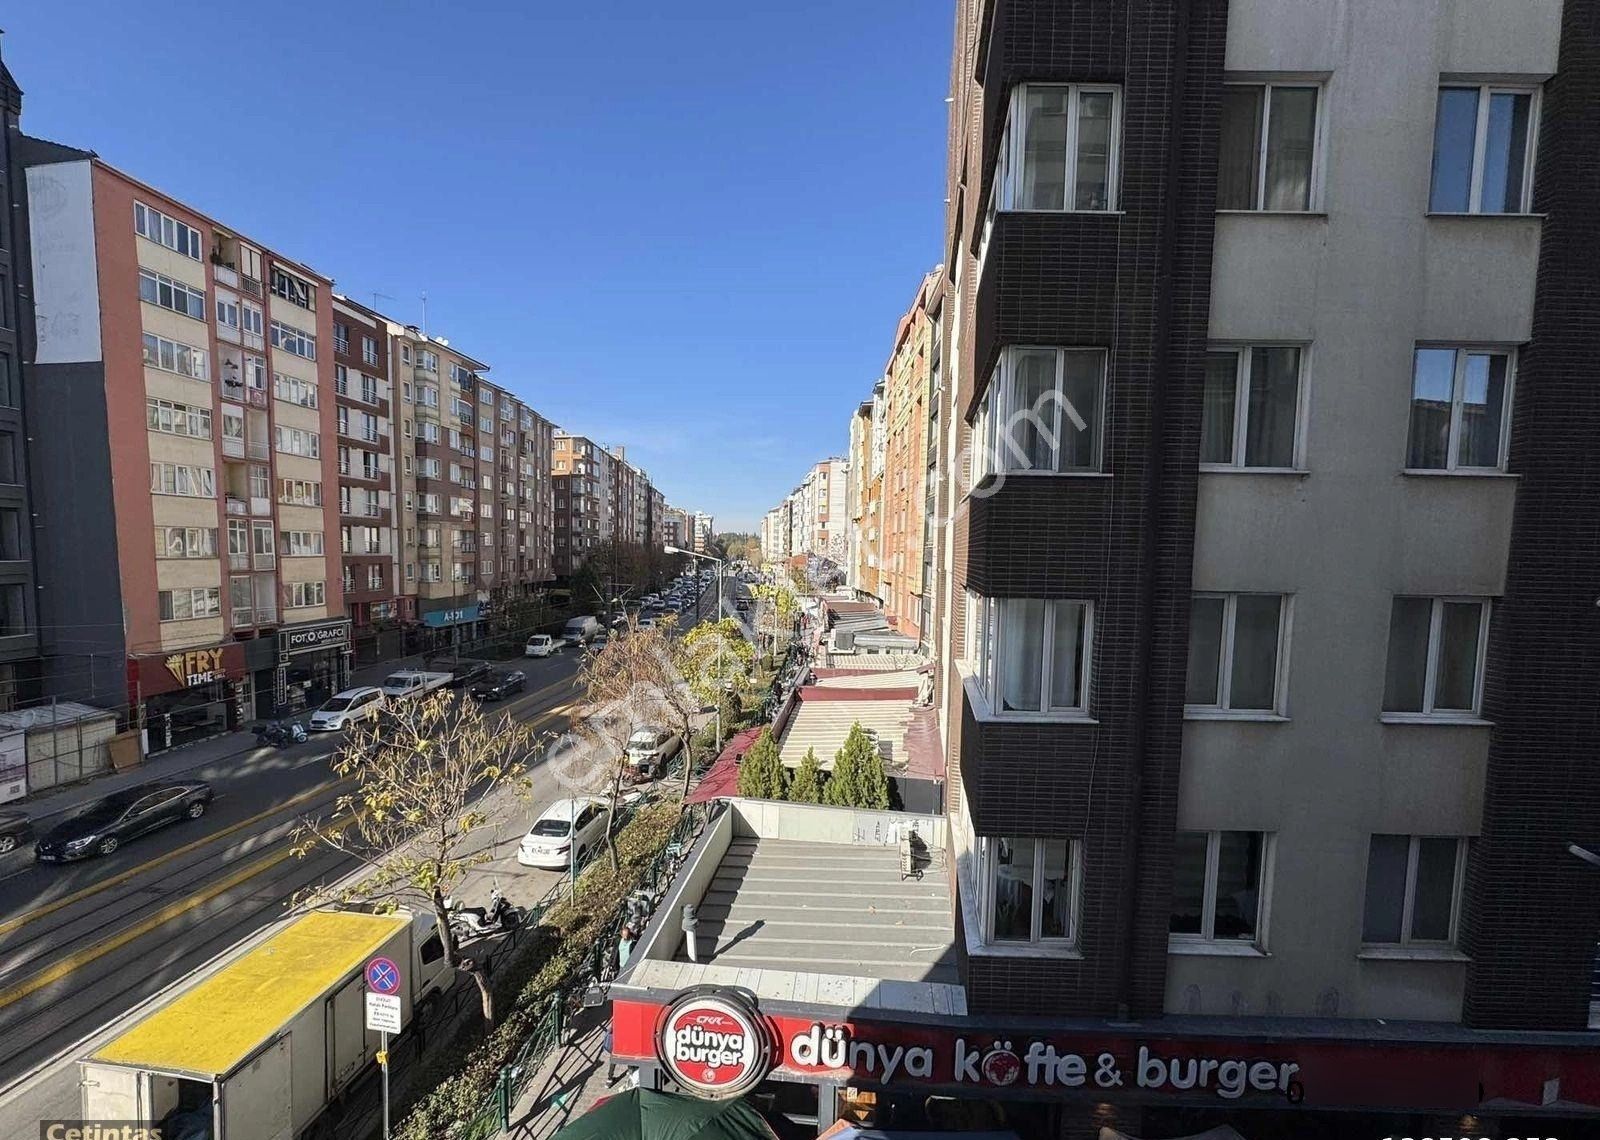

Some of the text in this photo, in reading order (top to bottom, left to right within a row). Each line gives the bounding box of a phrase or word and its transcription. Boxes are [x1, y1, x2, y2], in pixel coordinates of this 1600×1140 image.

[185, 648, 224, 675] FRY
[187, 671, 213, 687] TIME
[677, 1024, 743, 1052] dünya
[677, 1043, 742, 1068] burger
[791, 1025, 1300, 1098] dünya köfte & burger
